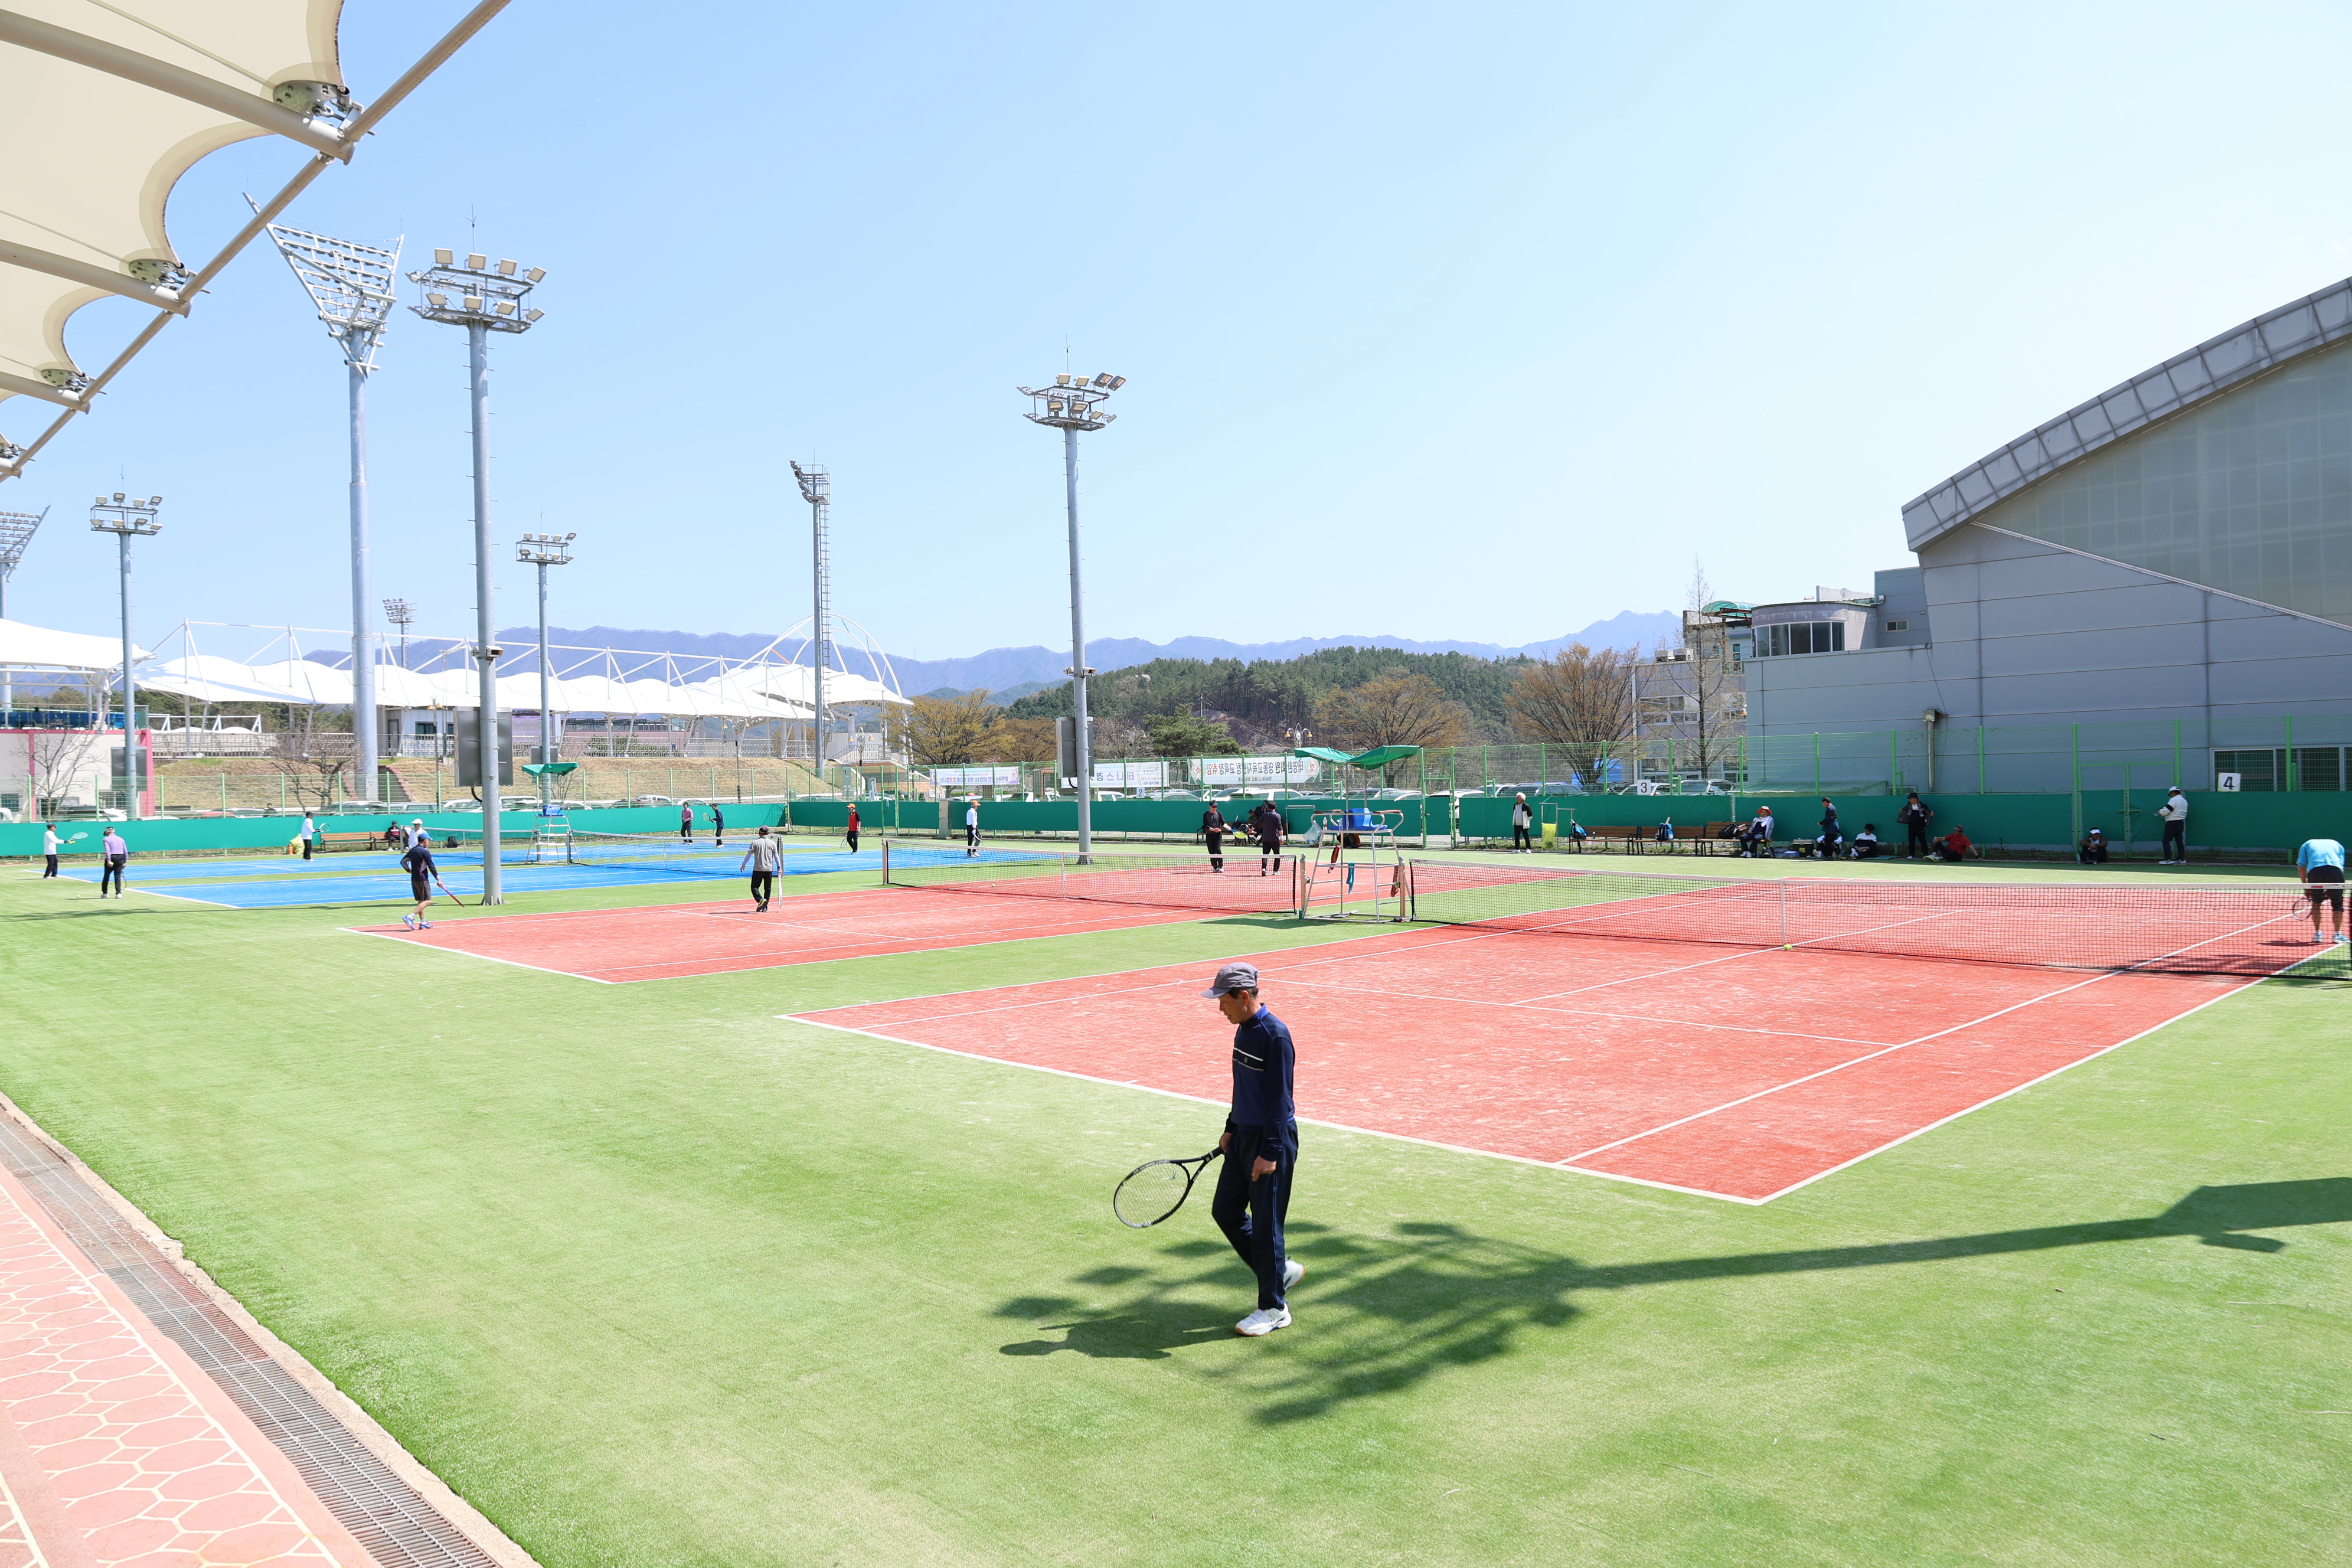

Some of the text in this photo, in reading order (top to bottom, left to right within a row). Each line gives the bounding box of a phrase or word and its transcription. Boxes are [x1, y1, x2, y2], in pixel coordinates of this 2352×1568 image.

[1641, 782, 1647, 793] 3
[2223, 776, 2234, 789] 4
[1138, 789, 1142, 797] 2
